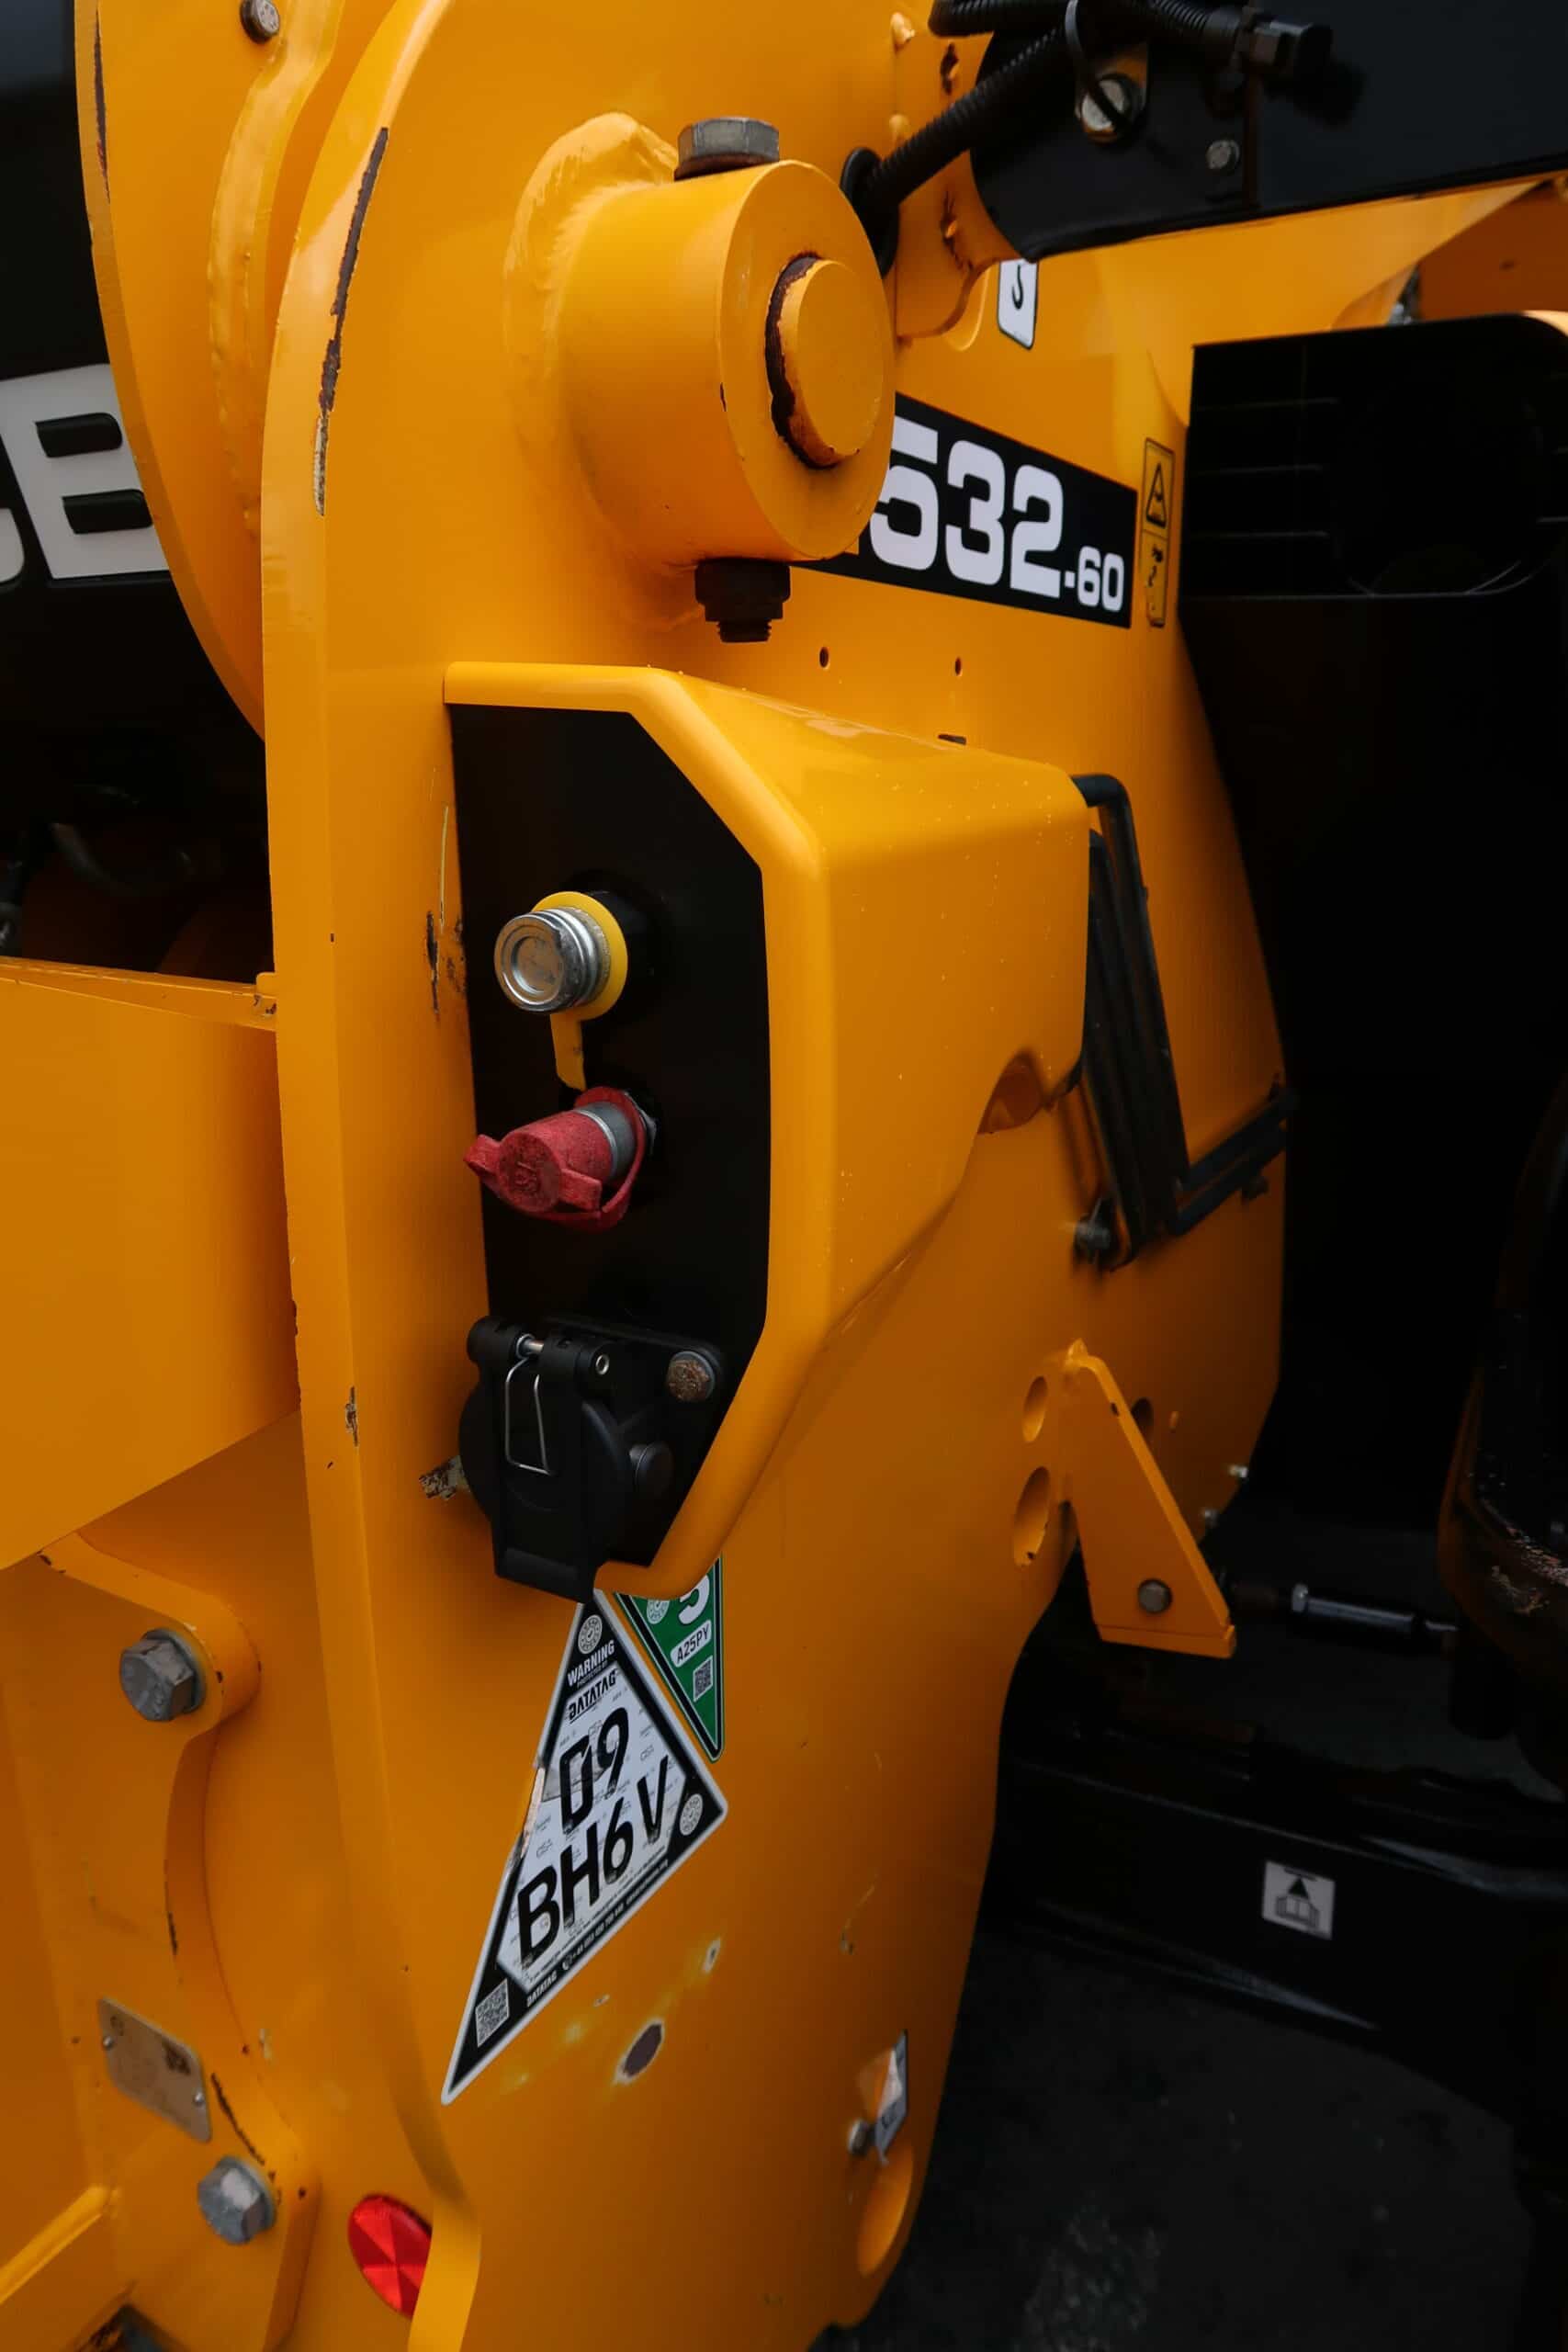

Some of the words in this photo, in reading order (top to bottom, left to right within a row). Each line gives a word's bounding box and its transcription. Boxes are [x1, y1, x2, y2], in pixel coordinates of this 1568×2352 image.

[567, 1639, 615, 1687] WARNING
[677, 1624, 710, 1664] A25PY
[569, 1668, 618, 1721] DATATAG
[517, 1755, 669, 1969] BH6V
